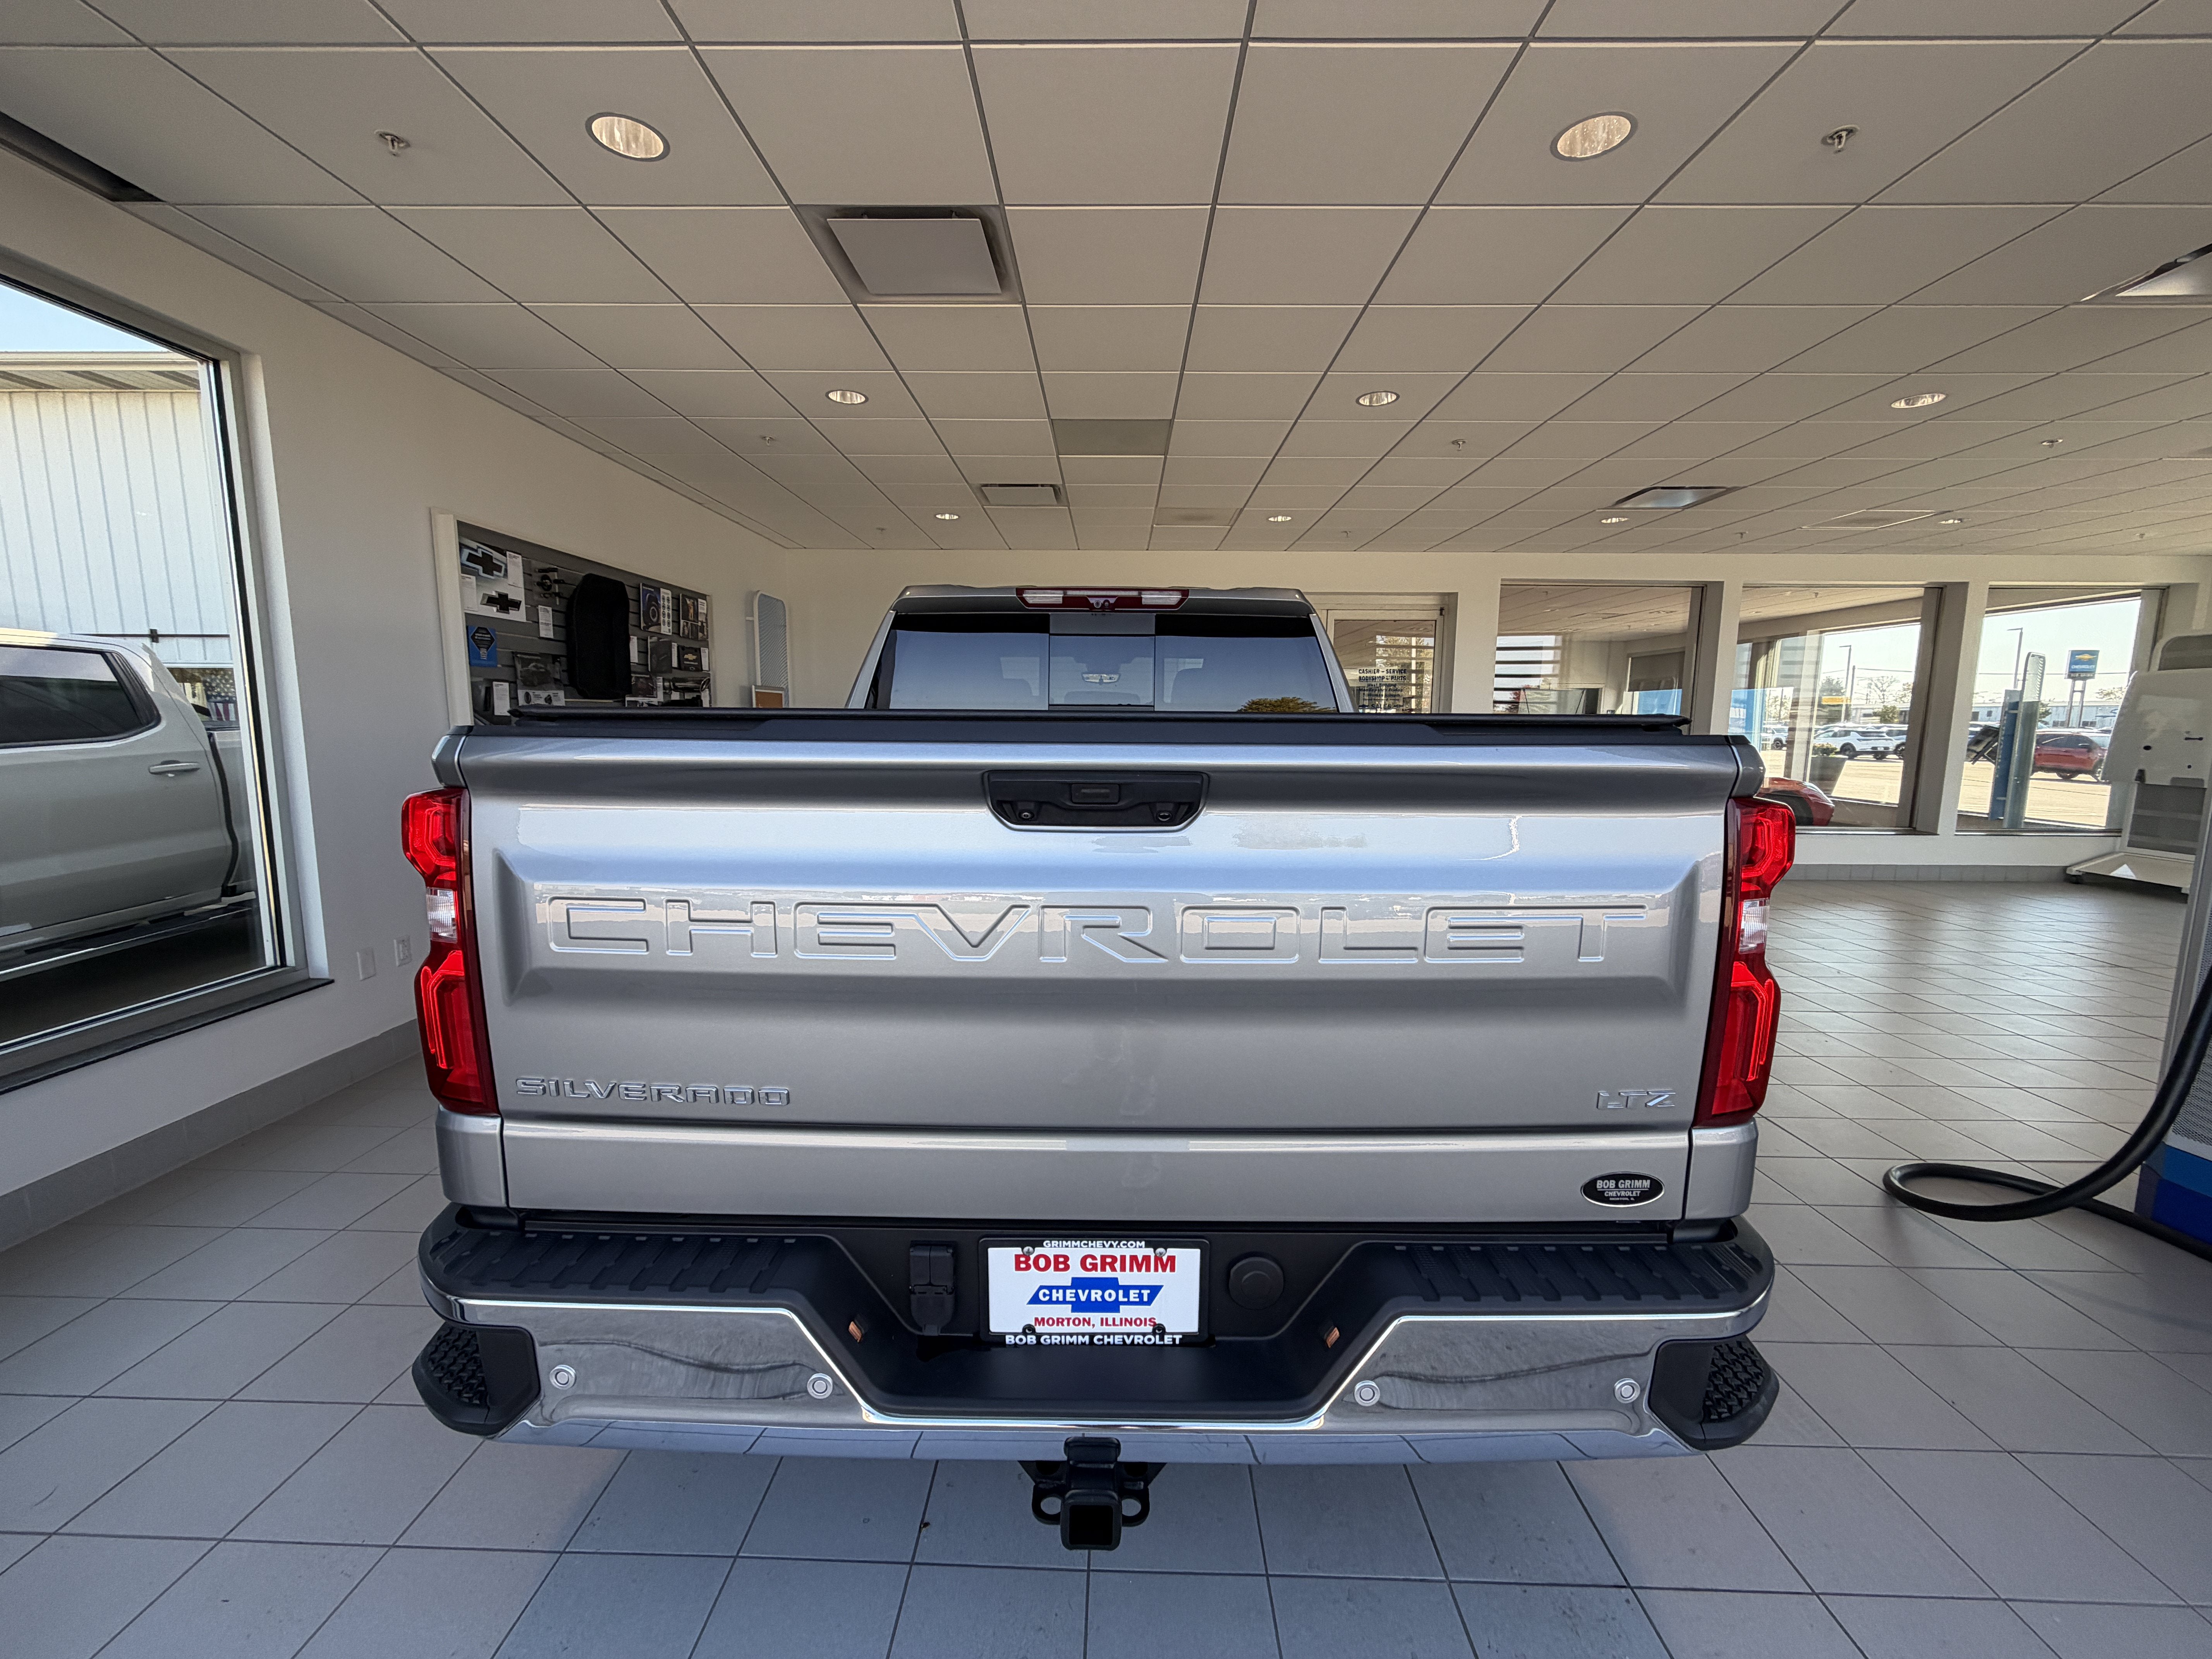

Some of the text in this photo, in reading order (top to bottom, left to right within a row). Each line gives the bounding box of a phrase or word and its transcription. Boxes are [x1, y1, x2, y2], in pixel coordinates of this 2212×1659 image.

[546, 896, 1647, 963] CHEVROLET
[515, 1078, 789, 1105] SILVERADO
[1596, 1090, 1676, 1109] LTZ
[1597, 1180, 1650, 1188] BOB GRIMM
[1015, 1254, 1176, 1273] BOB GRIMM
[1038, 1289, 1150, 1302] CHEVROLET
[1034, 1317, 1157, 1329] MORTON, ILLINOIS
[1006, 1335, 1182, 1345] BOB GRIMM CHEVROLET
